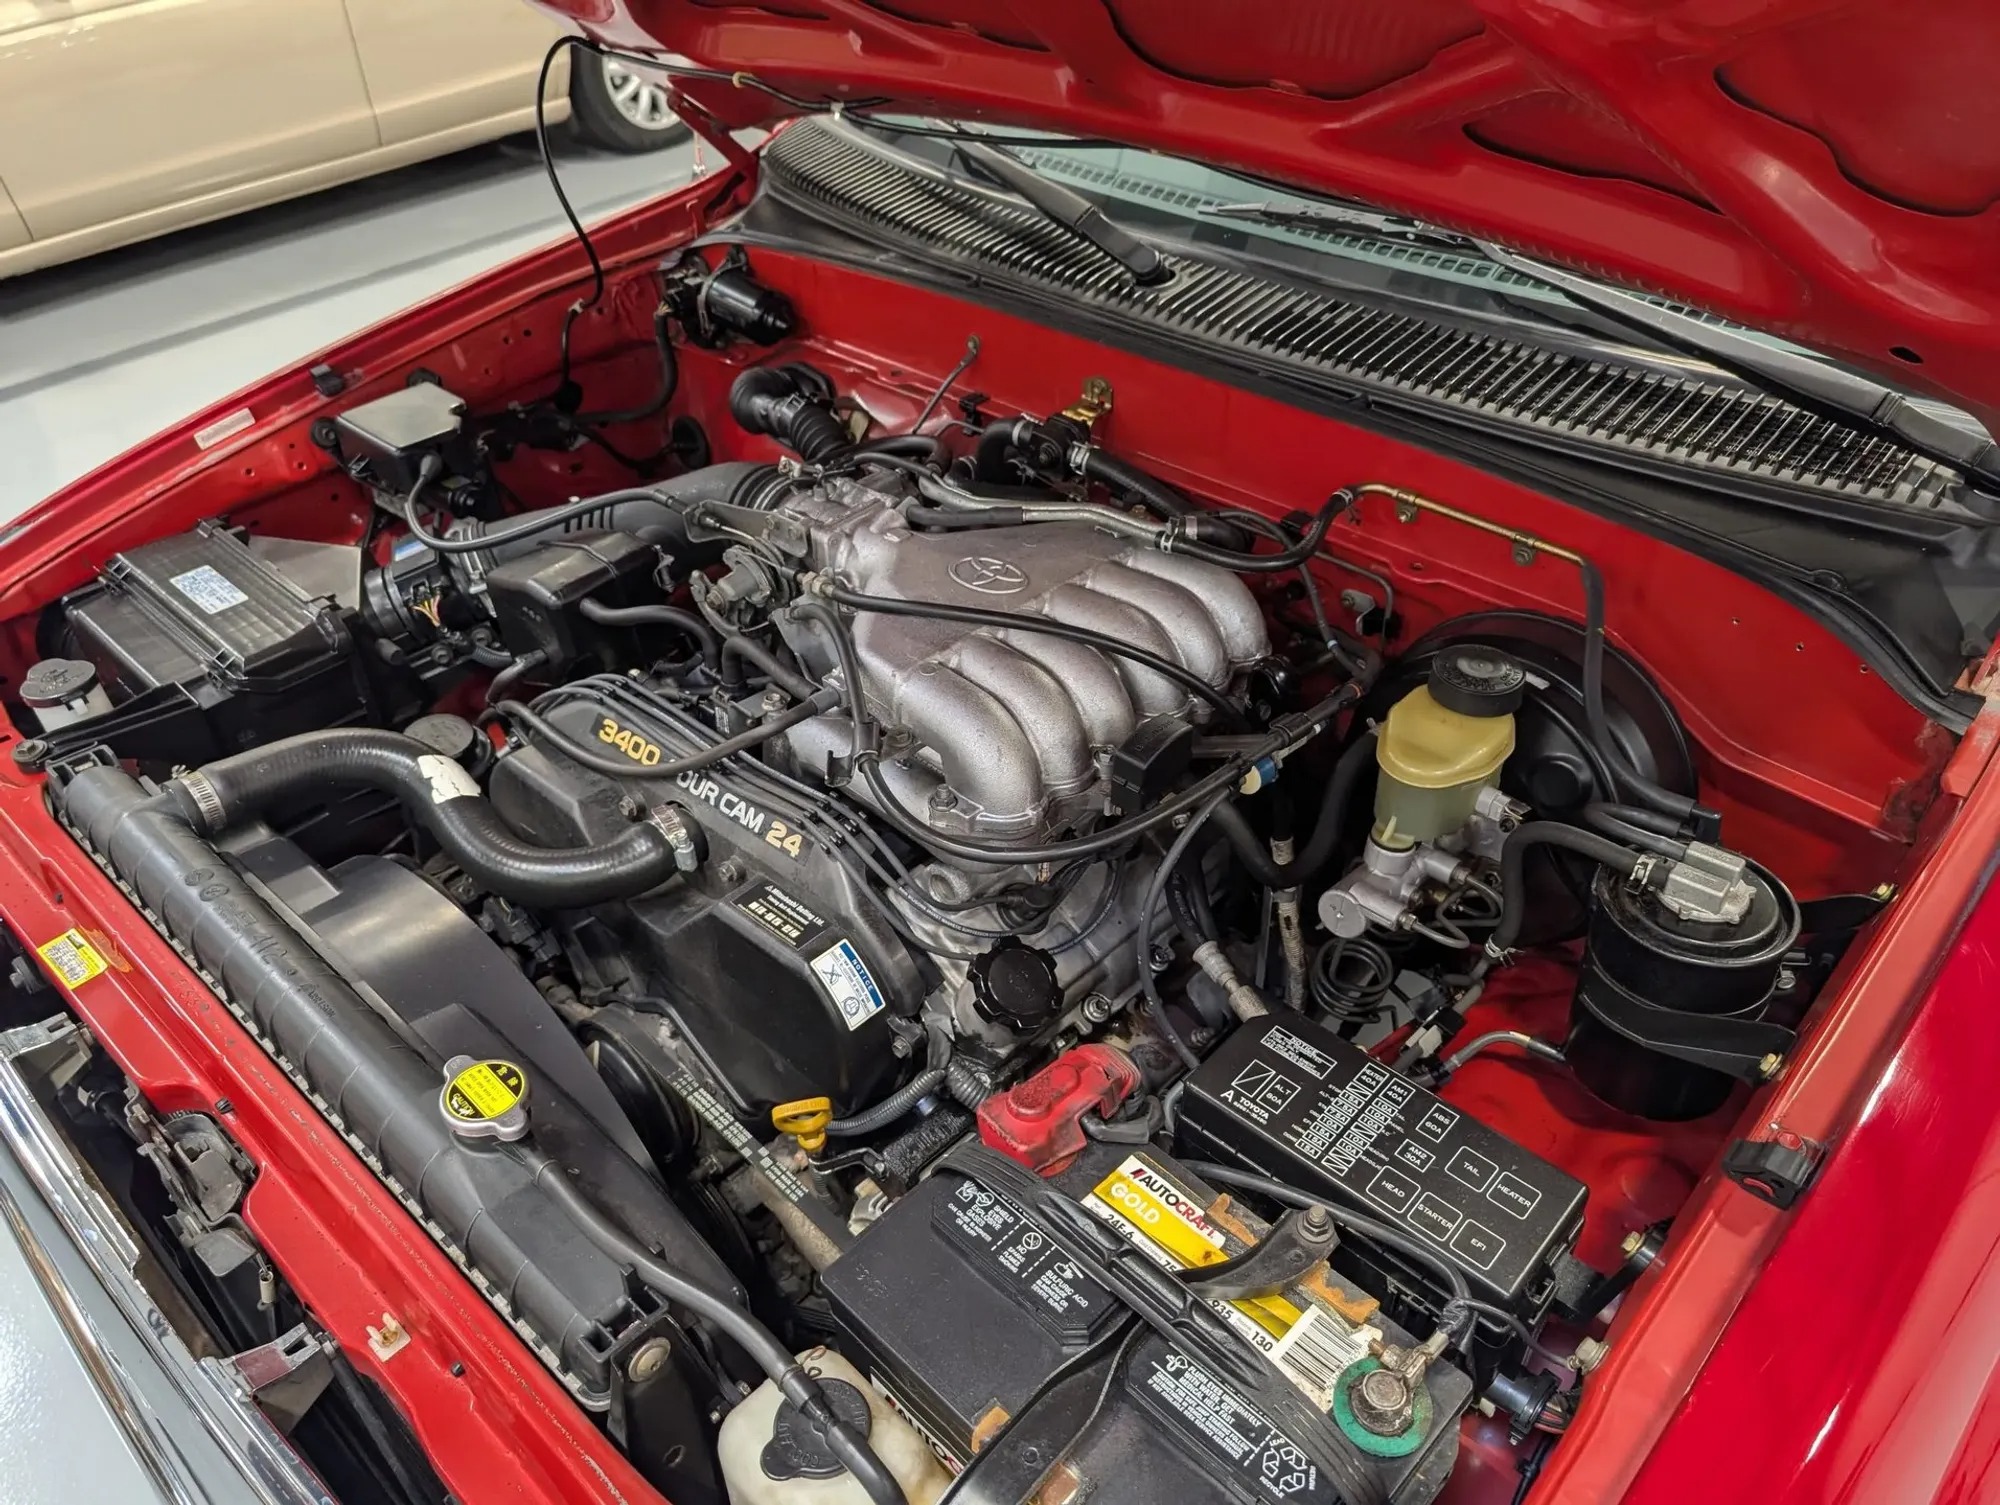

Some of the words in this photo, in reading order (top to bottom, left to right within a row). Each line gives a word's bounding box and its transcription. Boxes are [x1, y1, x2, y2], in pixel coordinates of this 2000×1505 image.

[599, 718, 661, 766] 3400
[673, 763, 719, 806] OUR
[719, 792, 766, 834] CAM
[764, 820, 803, 858] 24
[852, 959, 874, 991] NOTICE
[1361, 1074, 1377, 1087] 40A
[1220, 1089, 1235, 1102] A
[1273, 1083, 1292, 1096] ALT
[1387, 1090, 1403, 1102] 40A
[1391, 1085, 1408, 1096] AM1
[1343, 1093, 1359, 1105] 15A
[1239, 1096, 1270, 1120] TOYOTA
[1370, 1109, 1385, 1121] 10A
[1377, 1102, 1392, 1113] 10A
[1322, 1118, 1338, 1130] 10A
[1363, 1117, 1379, 1129] 10A
[1432, 1112, 1451, 1126] ABS
[1315, 1126, 1330, 1138] 15A
[1425, 1120, 1444, 1135] 60A
[1307, 1133, 1323, 1145] 15A
[1349, 1134, 1364, 1146] 10A
[1300, 1142, 1316, 1154] 15A
[1342, 1142, 1357, 1154] 10A
[1409, 1146, 1427, 1160] AM2
[1404, 1152, 1421, 1166] 30A
[1463, 1161, 1481, 1178] TAIL
[1381, 1180, 1406, 1198] HEAD
[1497, 1183, 1532, 1208] HEATER
[1110, 1182, 1160, 1224] GOLD
[1139, 1175, 1215, 1238] AUTOCRAFT
[965, 1208, 986, 1227] GASES
[970, 1203, 1001, 1230] EXPLOSIVE
[987, 1209, 1004, 1224] EYES
[993, 1204, 1014, 1223] SHIELD
[1418, 1203, 1453, 1230] STARTER
[1015, 1243, 1027, 1254] NO
[1470, 1237, 1487, 1252] EFI
[1040, 1274, 1052, 1285] CAN
[1049, 1283, 1067, 1298] CAUSE
[1044, 1269, 1074, 1295] SULFURIC
[1071, 1292, 1089, 1308] ACID
[1105, 1214, 1135, 1240] 24F-6
[1160, 1259, 1178, 1273] 75
[1250, 1330, 1274, 1352] 130
[1058, 1298, 1069, 1307] OR
[1175, 1387, 1186, 1397] FOR
[1182, 1371, 1200, 1386] WITH
[1220, 1402, 1234, 1414] GET
[1187, 1365, 1209, 1383] FLUSH
[1206, 1381, 1223, 1396] EYES
[1220, 1393, 1262, 1428] IMMEDIATELY
[1177, 1376, 1205, 1399] MEDICAL
[1202, 1397, 1220, 1412] HELP
[1217, 1409, 1235, 1425] FAST
[1269, 1437, 1286, 1447] LEAD
[1259, 1475, 1286, 1499] RECYCLE
